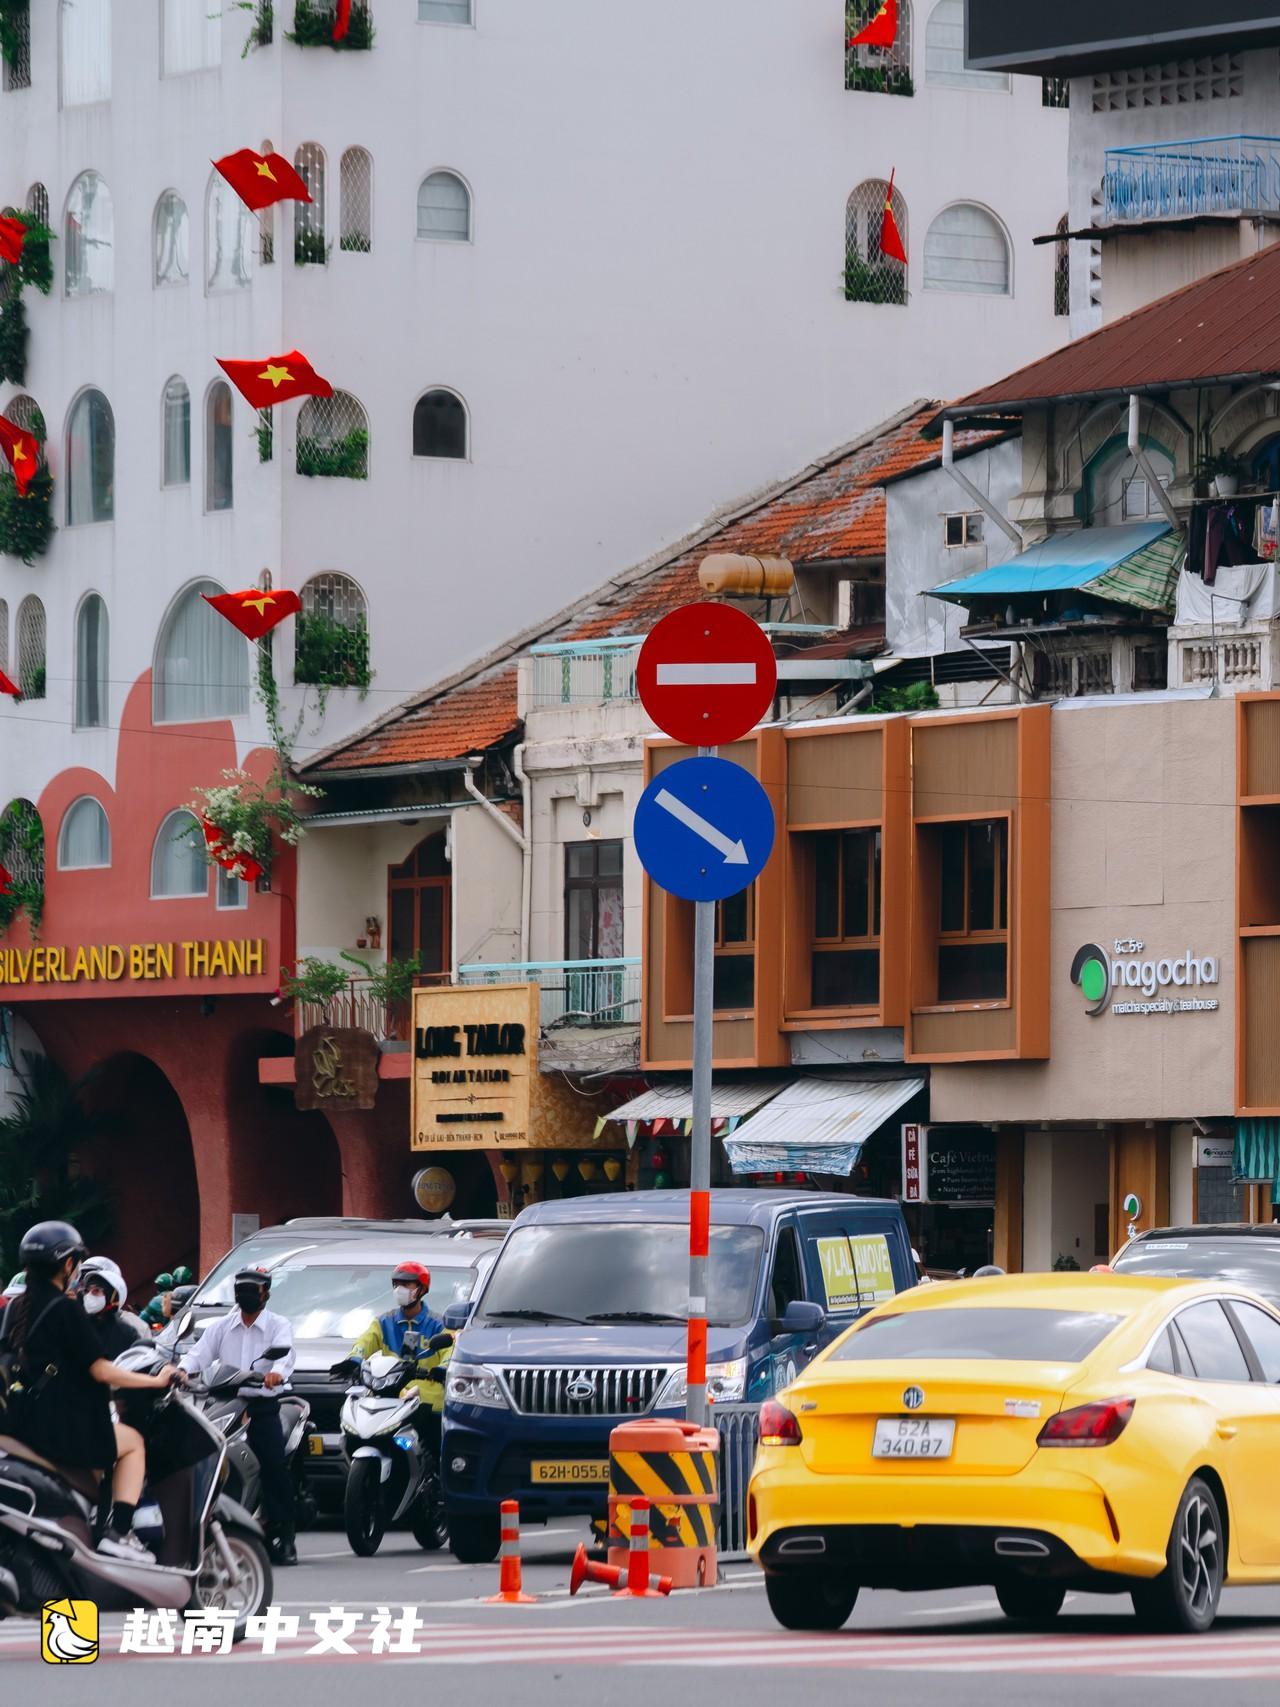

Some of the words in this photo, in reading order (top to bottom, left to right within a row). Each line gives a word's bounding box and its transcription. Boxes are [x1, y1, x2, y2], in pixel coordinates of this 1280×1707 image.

[130, 943, 173, 979] BEN
[182, 938, 263, 977] THANH
[1112, 946, 1218, 997] nagocha
[416, 1026, 461, 1058] LONG
[463, 1023, 526, 1055] TAILOR
[468, 1069, 510, 1082] TAILOR
[930, 1151, 957, 1167] Café
[898, 1421, 930, 1436] 62A
[881, 1439, 943, 1455] 340.87
[540, 1465, 610, 1479] 62H-055.6
